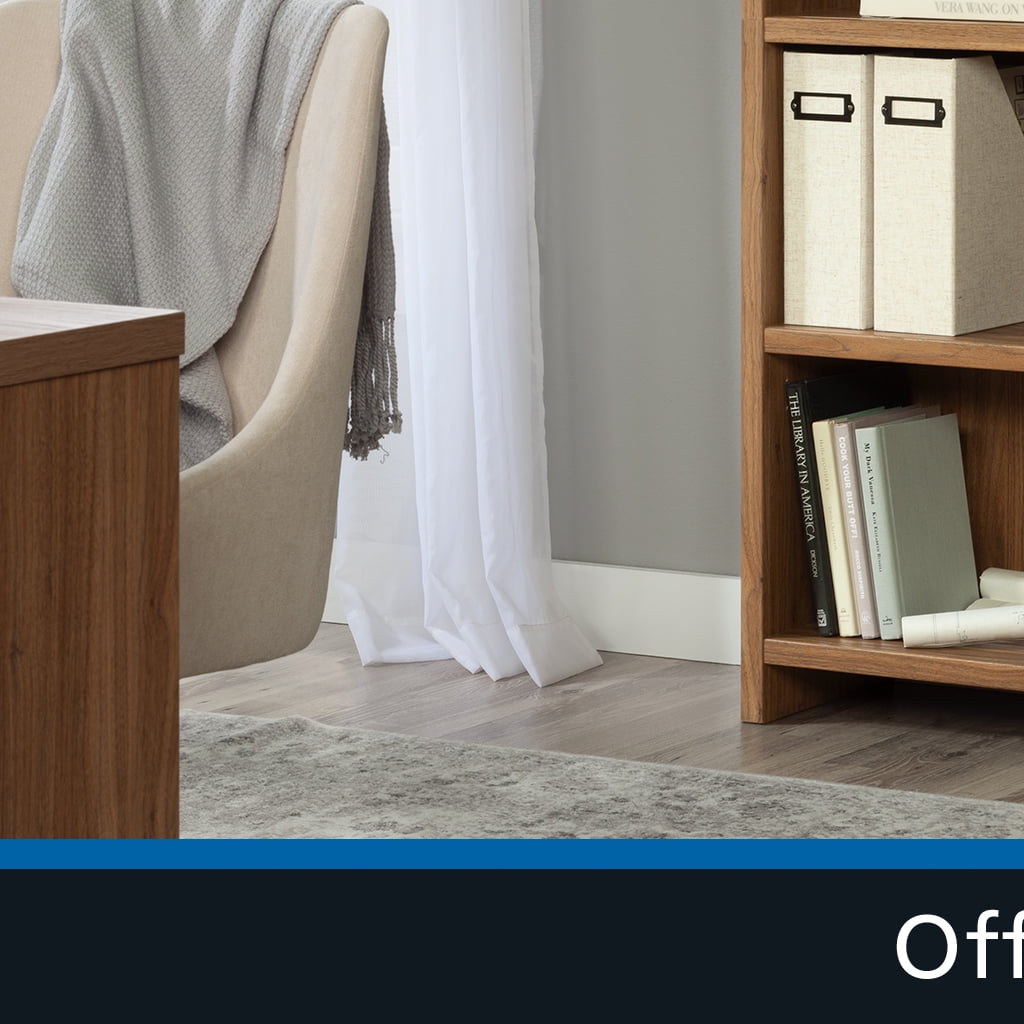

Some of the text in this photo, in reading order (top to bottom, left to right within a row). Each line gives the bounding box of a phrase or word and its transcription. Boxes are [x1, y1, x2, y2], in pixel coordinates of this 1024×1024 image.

[934, 1, 963, 14] VERA
[966, 2, 999, 15] WANG
[1002, 3, 1020, 15] ON
[863, 442, 870, 453] My
[788, 392, 816, 542] THE LIBRARY IN AMERICA
[865, 456, 873, 474] Dark
[838, 436, 858, 539] COOK YOUR BUTT OFF!
[809, 549, 819, 578] DICKSON
